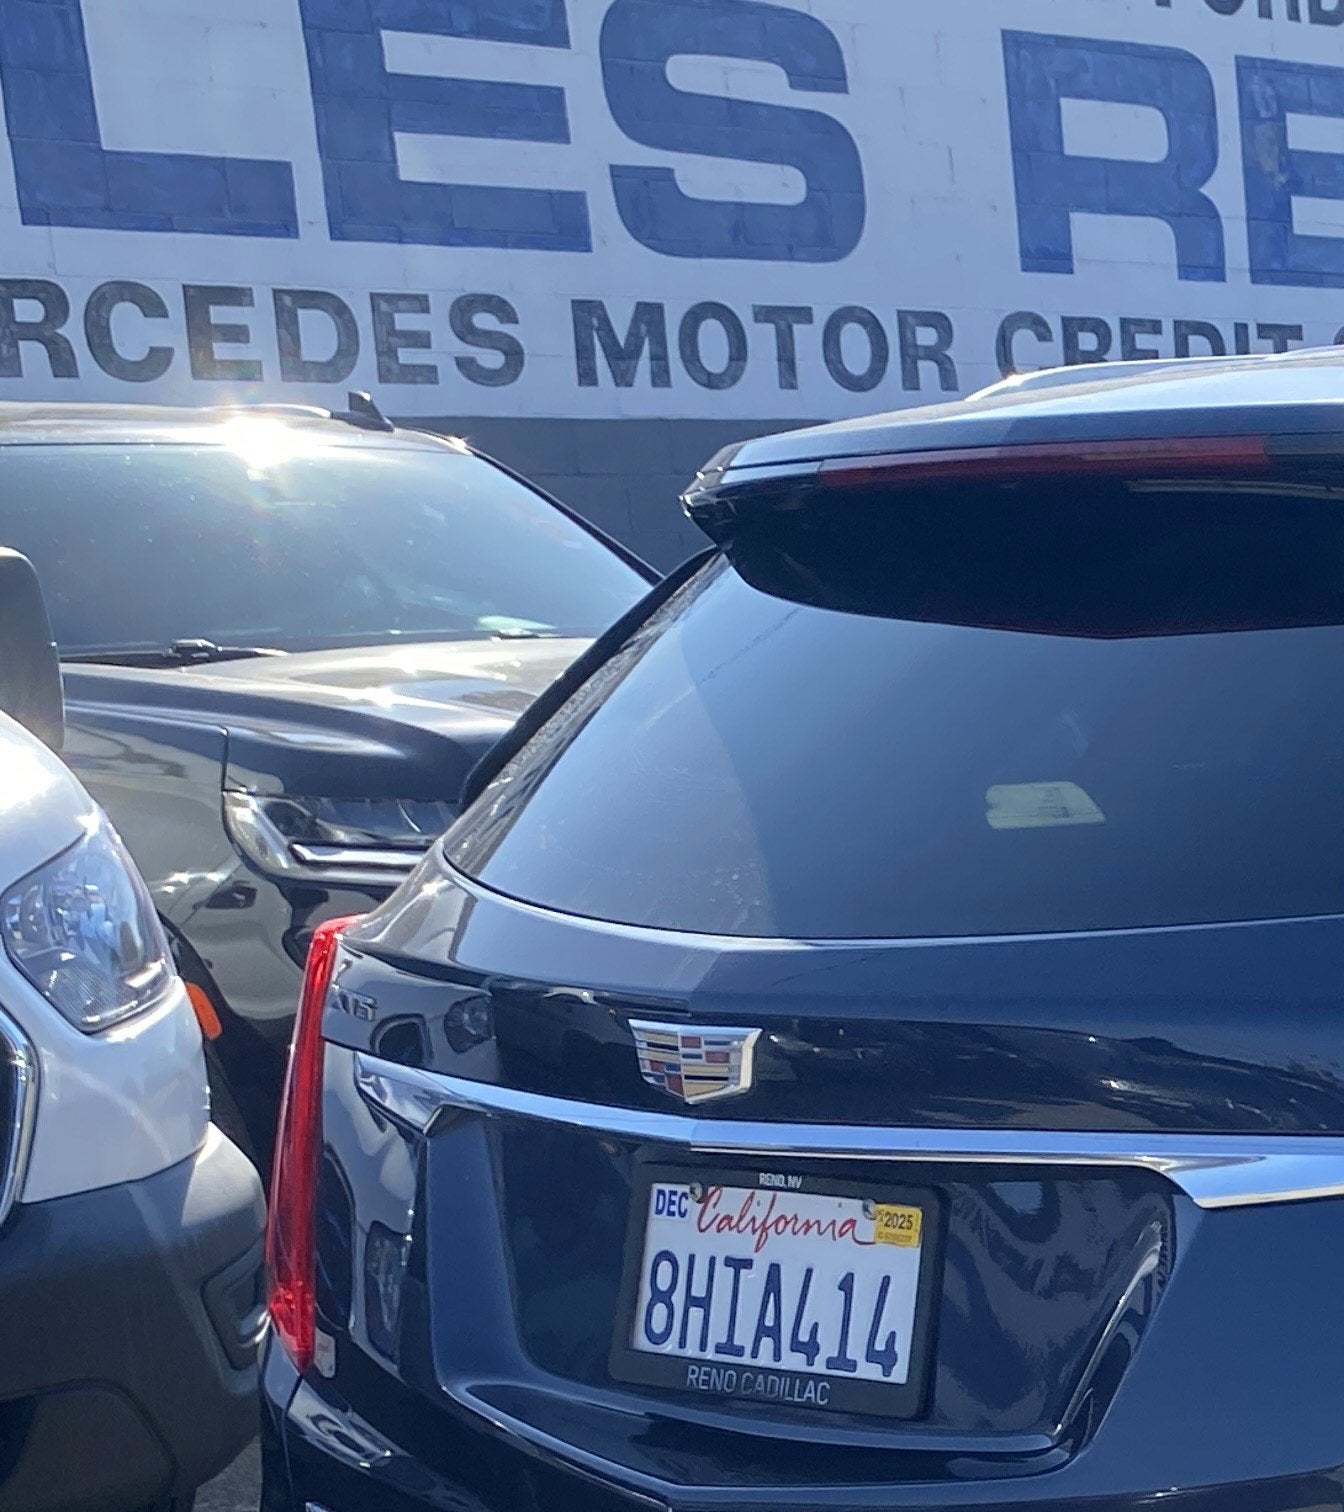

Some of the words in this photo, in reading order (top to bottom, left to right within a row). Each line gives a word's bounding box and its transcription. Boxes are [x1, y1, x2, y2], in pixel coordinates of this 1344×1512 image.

[571, 299, 959, 393] MOTOR
[787, 1175, 803, 1189] NV
[654, 1189, 689, 1218] DEC
[697, 1185, 876, 1253] California
[884, 1211, 914, 1231] 2025
[643, 1249, 899, 1377] 8HIA414
[686, 1365, 737, 1393] RENO
[741, 1372, 831, 1405] CADILLAC
